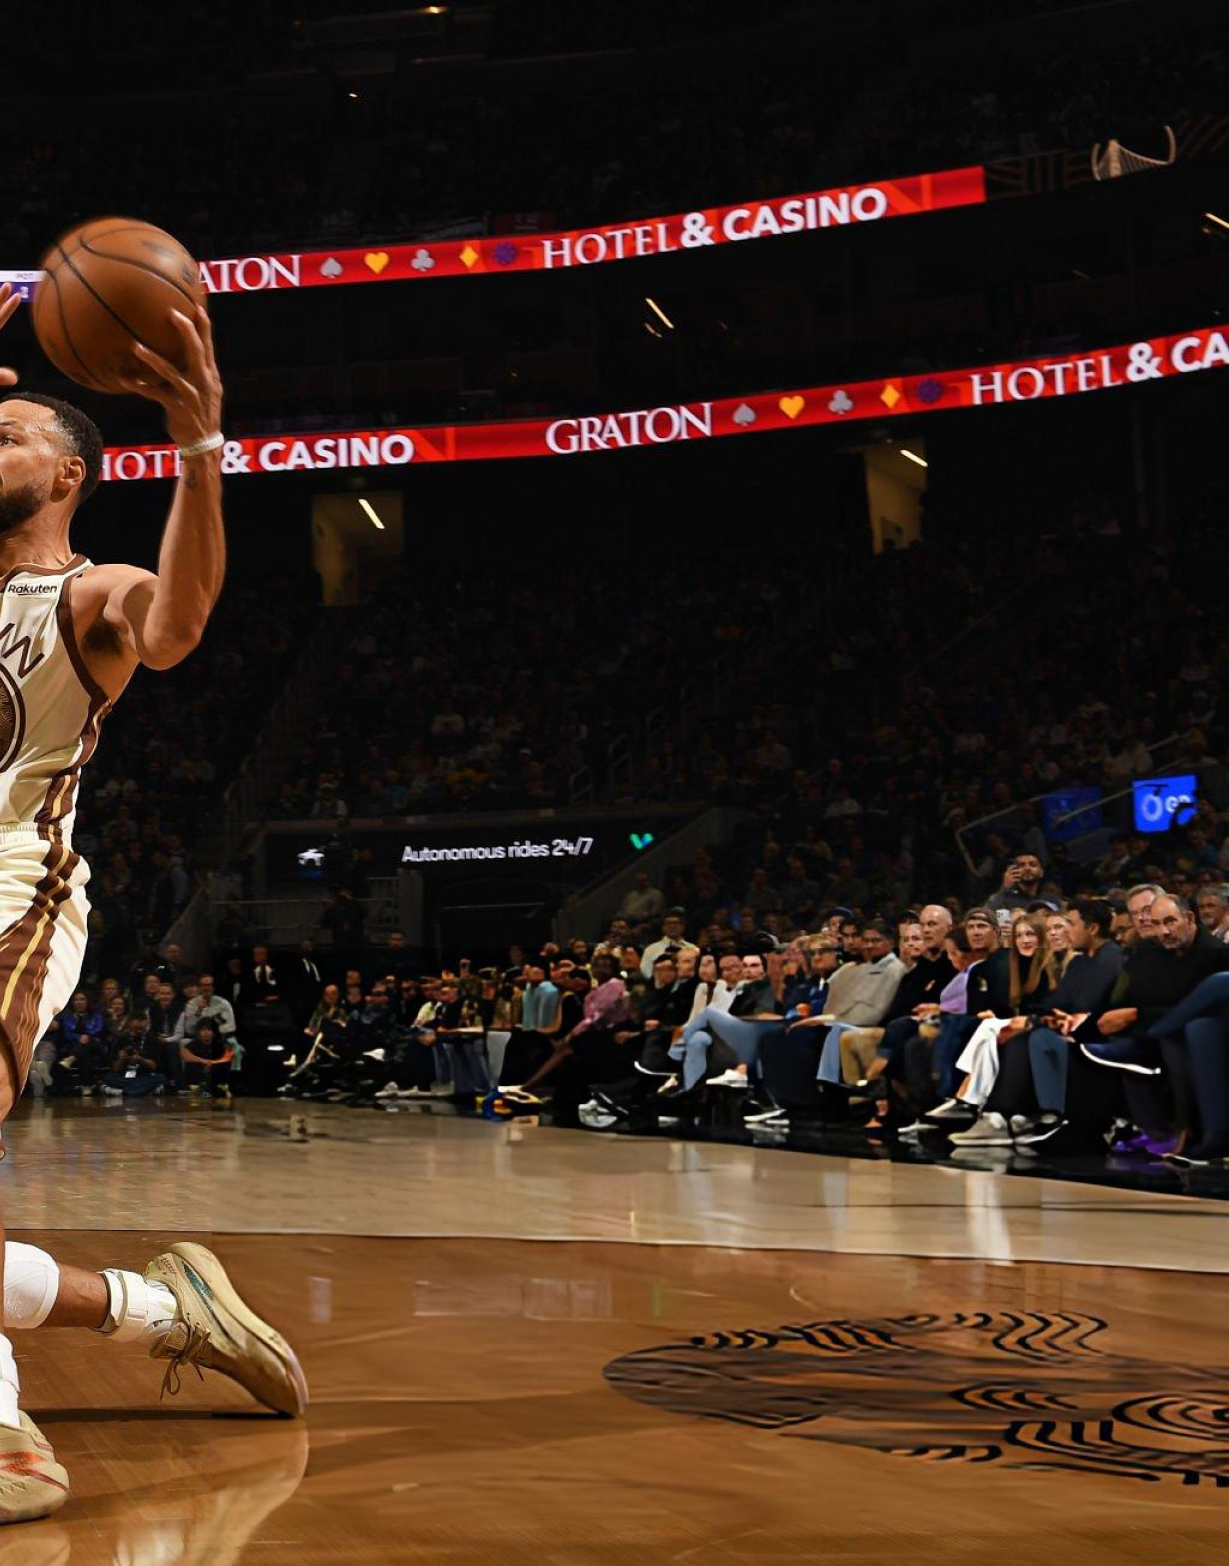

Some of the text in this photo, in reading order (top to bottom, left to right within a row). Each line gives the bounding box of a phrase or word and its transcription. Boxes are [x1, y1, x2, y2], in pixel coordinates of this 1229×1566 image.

[541, 187, 887, 269] HOTEL & CASINO
[197, 254, 301, 294] ATON
[970, 355, 1122, 405] HOTEL
[1126, 342, 1163, 383] &
[546, 403, 711, 454] GRATON
[219, 440, 253, 474] &
[259, 434, 414, 472] CASINO
[8, 583, 58, 596] Rakuten
[401, 836, 594, 863] Autonomous rides 24/7
